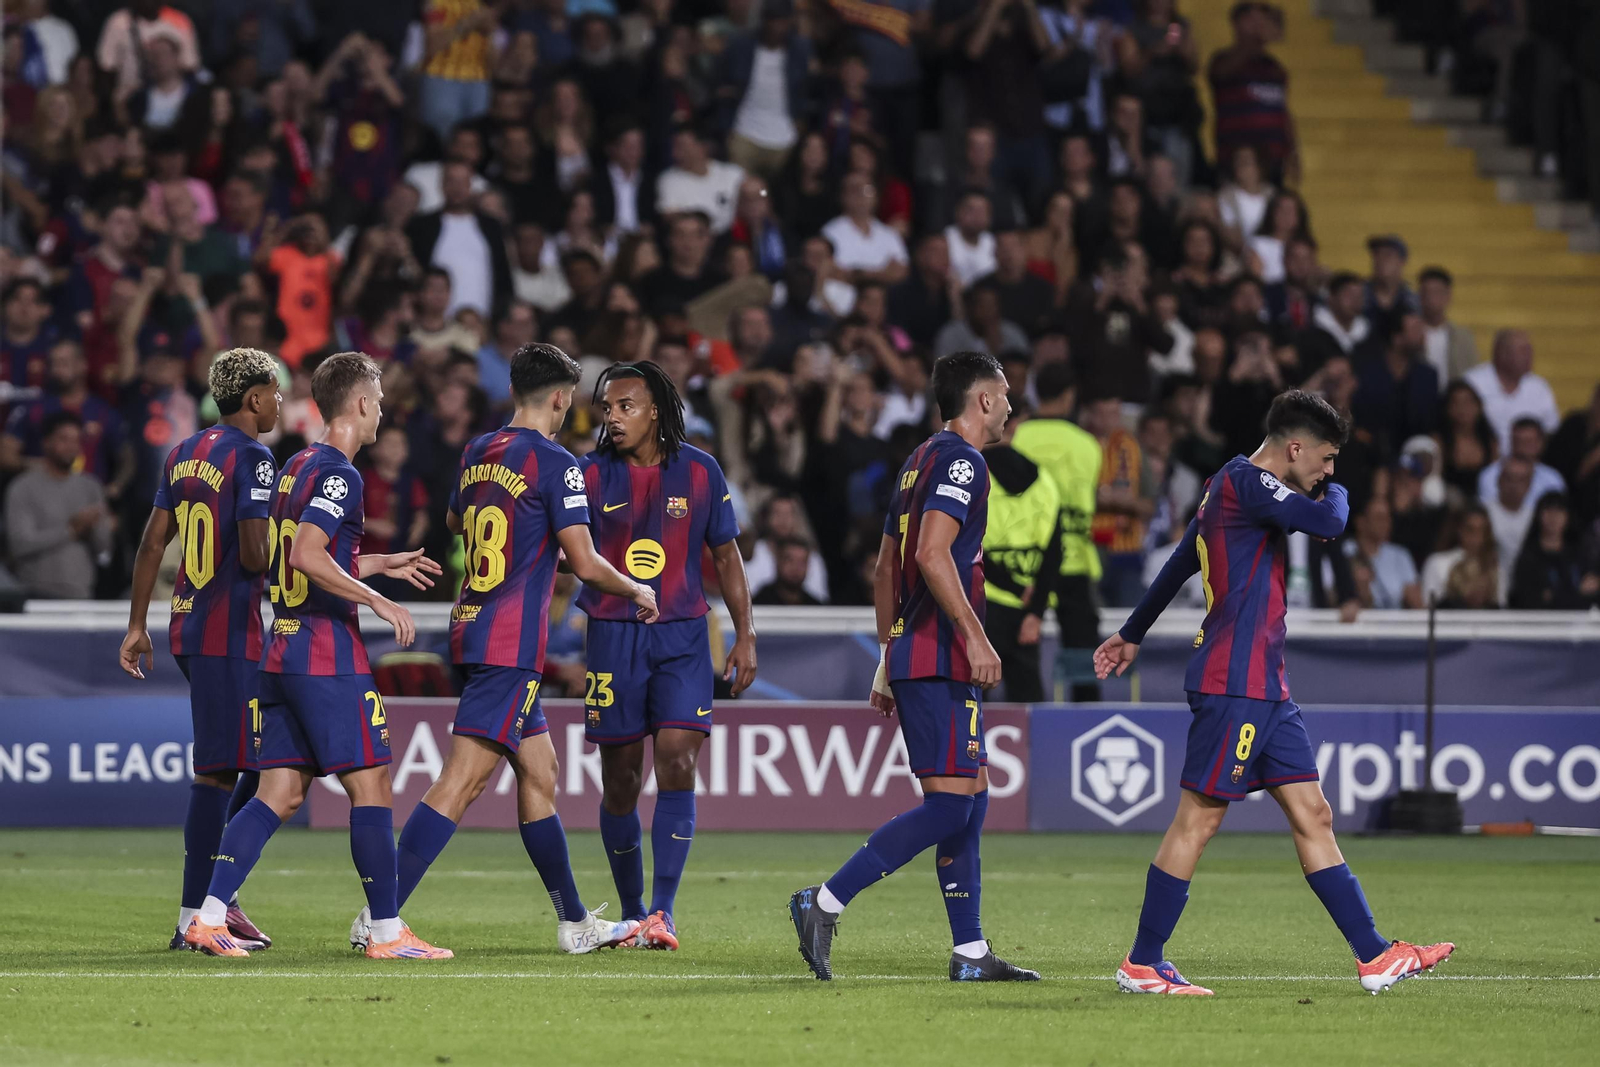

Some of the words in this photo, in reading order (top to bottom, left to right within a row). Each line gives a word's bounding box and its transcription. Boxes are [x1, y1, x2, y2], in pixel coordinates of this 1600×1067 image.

[170, 459, 199, 486] LAMINE
[197, 460, 225, 493] YAMAL
[490, 463, 528, 499] MARTÍN
[175, 500, 214, 590] 10
[463, 505, 509, 592] 18
[521, 680, 540, 716] 1
[585, 671, 615, 707] 23
[248, 698, 262, 733] 1
[364, 690, 387, 727] 2
[965, 700, 978, 737] 7
[1236, 723, 1256, 760] 8
[0, 742, 52, 783] NS
[68, 742, 195, 783] LEAG
[642, 724, 1026, 798] IRWAS
